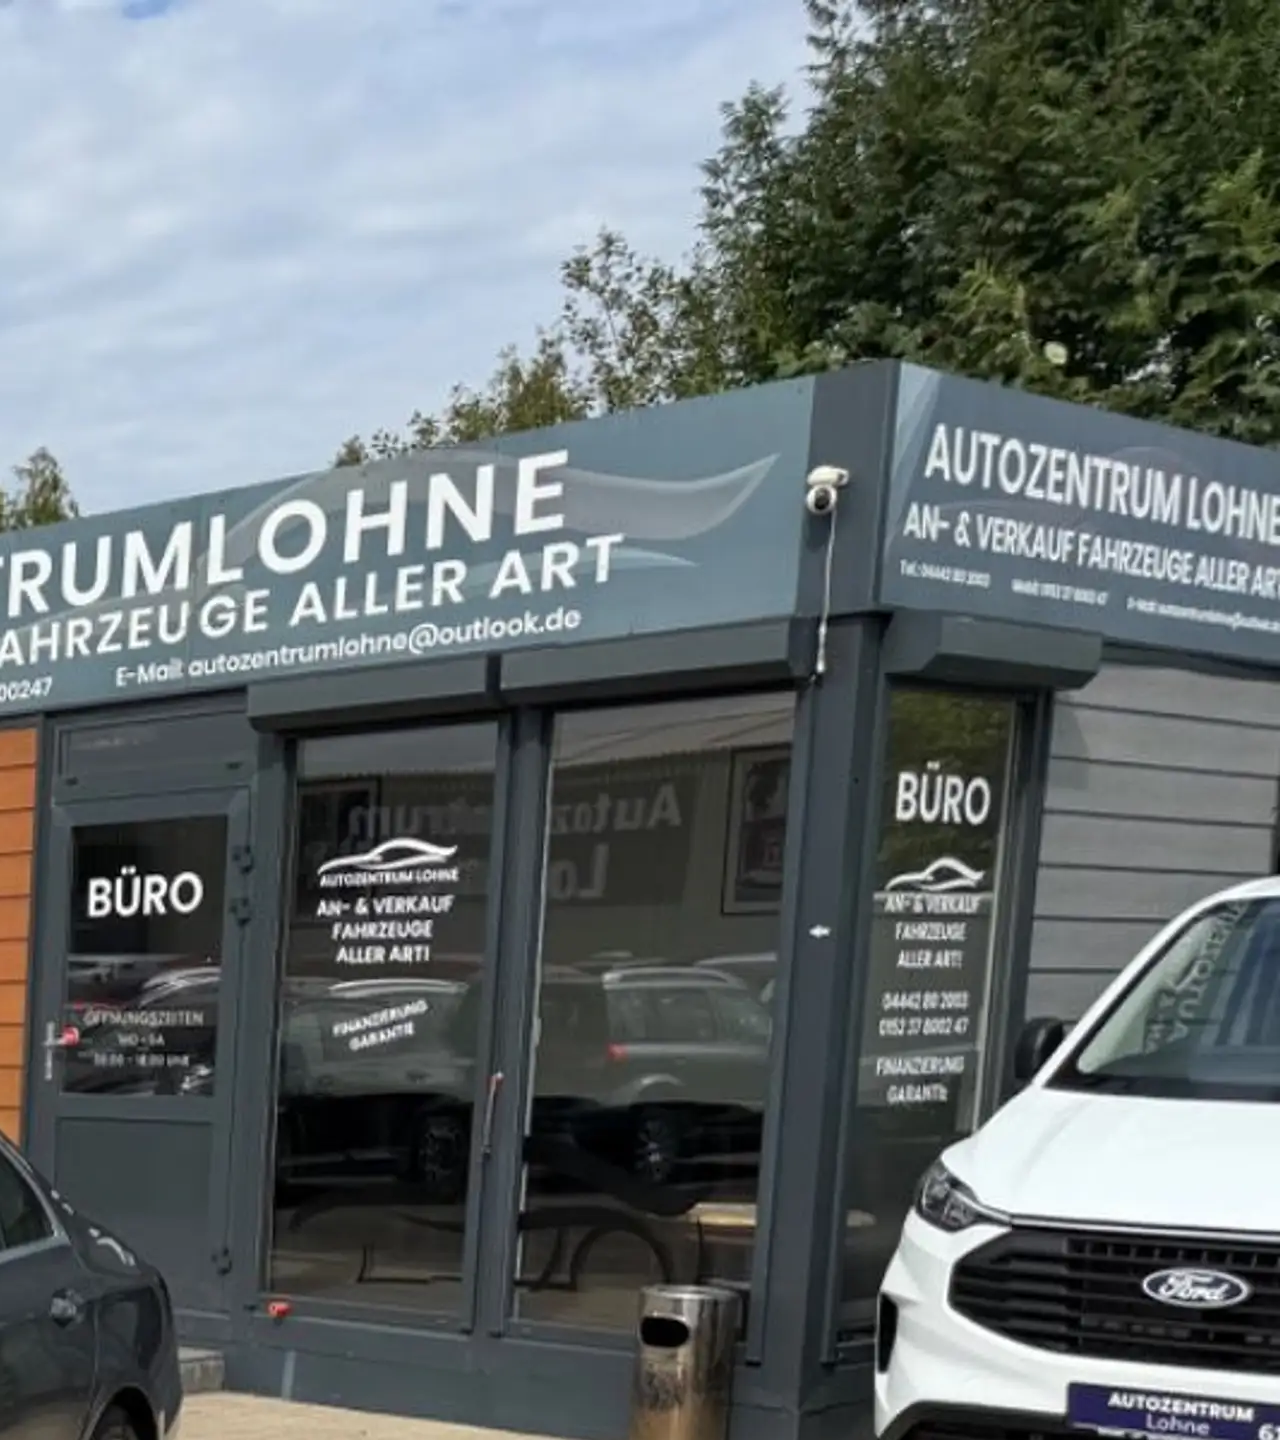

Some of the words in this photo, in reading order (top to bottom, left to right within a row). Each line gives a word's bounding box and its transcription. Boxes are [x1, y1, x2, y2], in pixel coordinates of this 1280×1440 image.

[924, 422, 1182, 526] AUTOZENTRUM
[1186, 475, 1280, 546] LOHNE
[903, 501, 950, 542] AN-
[954, 510, 971, 548] &
[976, 513, 1075, 564] VERKAUF
[1076, 532, 1194, 585] FAHRZEUGE
[1195, 554, 1250, 594] ALLER
[289, 558, 467, 628] ALLER
[488, 532, 626, 599] ART
[187, 606, 582, 678] autozentrumlohne@outlook.de
[895, 761, 991, 826] BÜRO
[87, 865, 204, 918] BÜRO
[320, 869, 413, 888] AUTOZENTRUM
[416, 866, 459, 883] LOHNE
[317, 899, 351, 917] AN-
[354, 897, 369, 915] &
[373, 894, 455, 915] VERKAUF
[331, 918, 434, 941] FAHRZEUGE
[336, 944, 385, 964] ALLER
[1159, 1268, 1229, 1301] Ford
[1108, 1391, 1255, 1423] AUTOZENTRUM
[1145, 1413, 1211, 1436] Lohne
